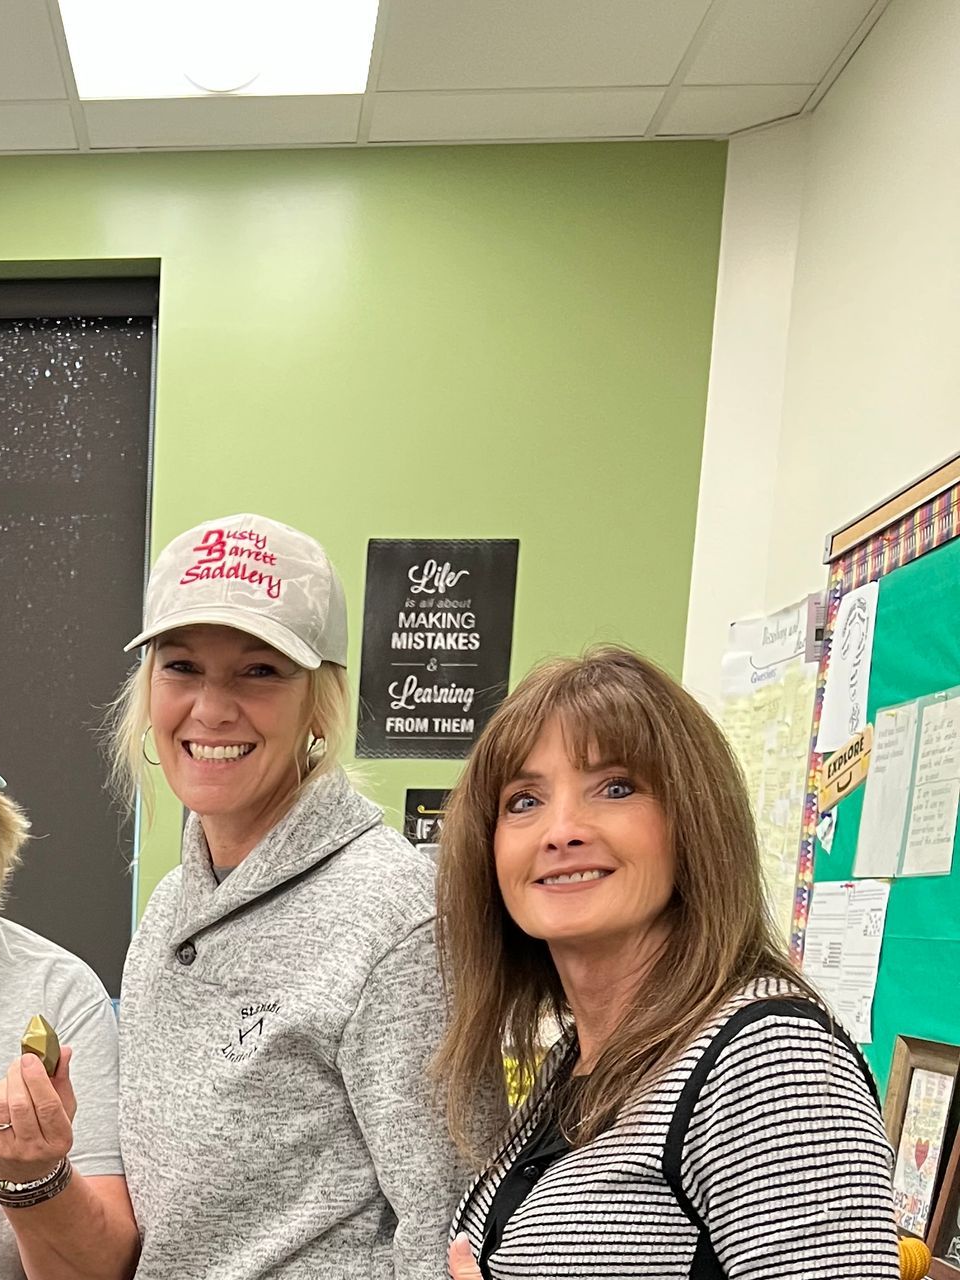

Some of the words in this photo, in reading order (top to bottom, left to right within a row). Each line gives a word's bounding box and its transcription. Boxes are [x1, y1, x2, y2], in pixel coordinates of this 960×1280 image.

[180, 562, 282, 598] Saddlery
[408, 559, 470, 594] Life
[405, 598, 416, 608] is
[419, 598, 434, 608] all
[436, 598, 472, 608] about
[398, 612, 476, 629] MAKING
[391, 632, 480, 650] MISTAKES
[426, 658, 438, 672] &
[388, 675, 474, 712] Learning
[386, 718, 428, 732] FROM
[432, 718, 474, 733] THEM
[828, 736, 864, 779] EXPLORE
[416, 818, 435, 840] IF
